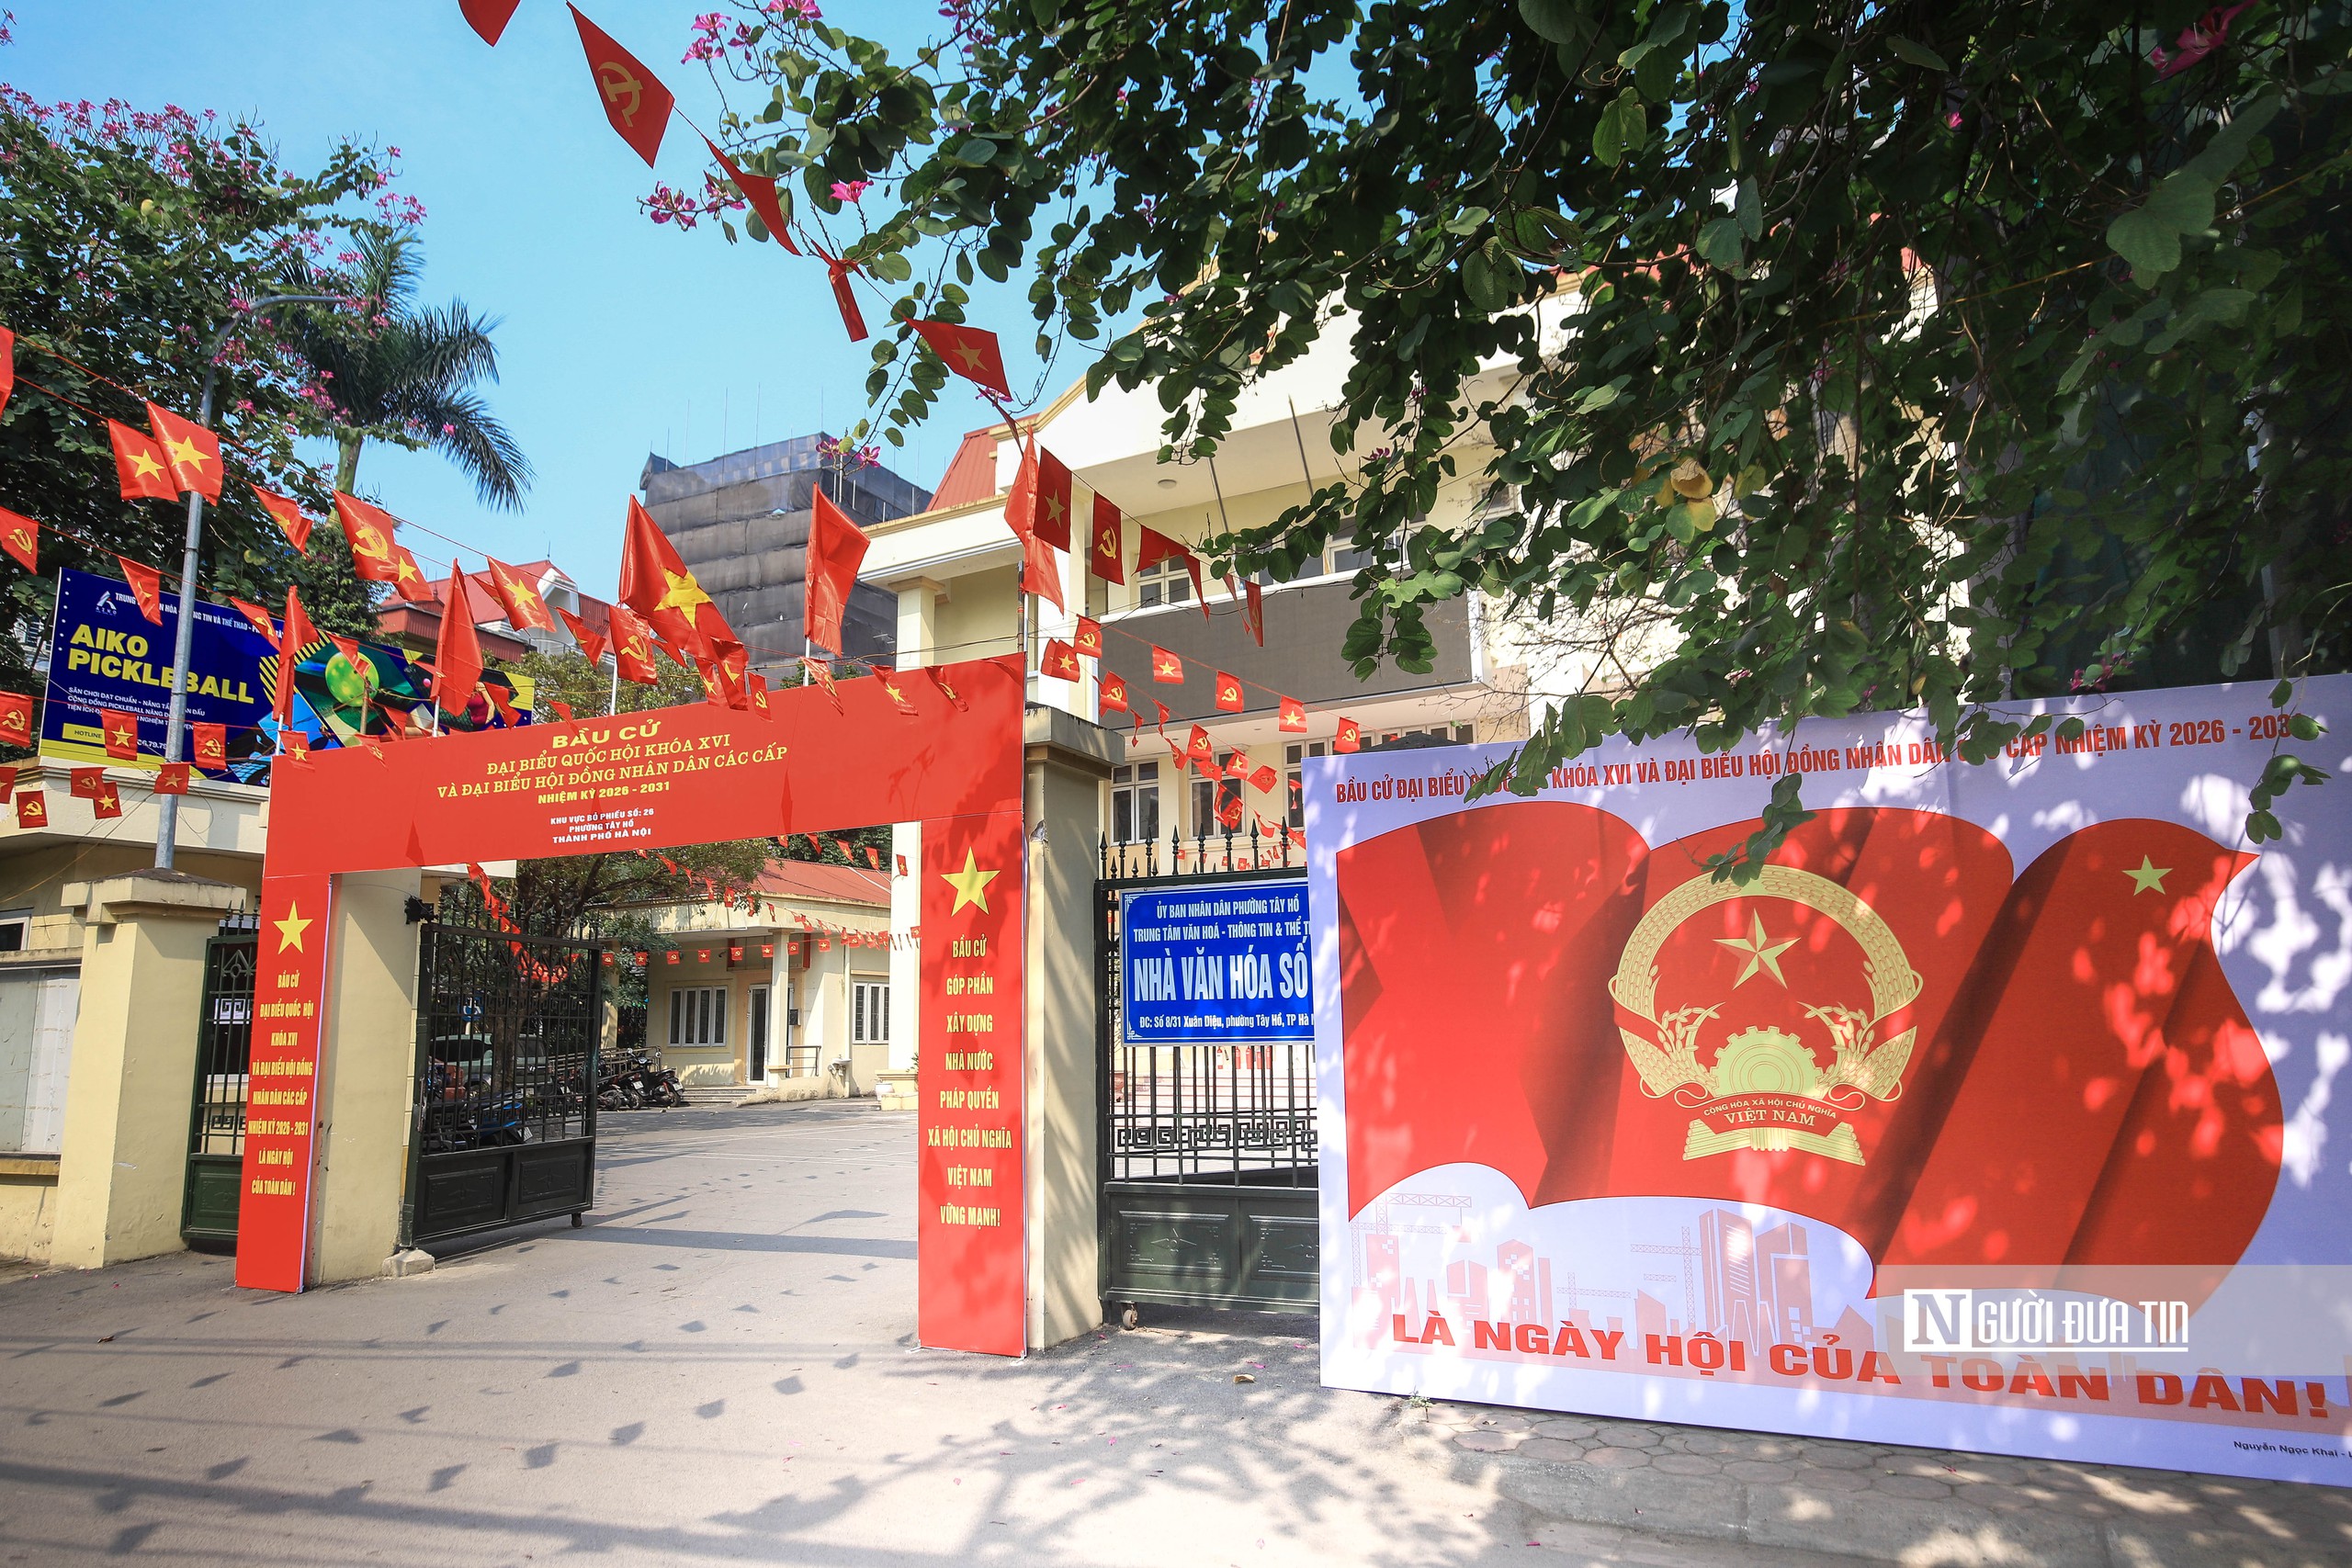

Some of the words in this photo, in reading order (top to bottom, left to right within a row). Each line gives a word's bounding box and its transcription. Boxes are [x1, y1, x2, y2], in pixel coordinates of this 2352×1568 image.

[116, 592, 136, 604] TRUNG
[202, 614, 212, 623] TIN
[233, 621, 248, 630] THAO
[70, 624, 148, 658] AIKO
[68, 648, 254, 704] PICKLEBALL
[108, 702, 144, 714] PICKLEBALL
[74, 729, 103, 739] HOTLINE
[553, 728, 610, 748] BẦU
[619, 718, 662, 740] CỬ
[487, 761, 515, 775] ĐẠI
[519, 750, 557, 772] BIỂU
[561, 746, 606, 766] QUỐC
[610, 743, 640, 761] HỘI
[645, 738, 693, 757] KHÓA
[698, 734, 730, 750] XVI
[1337, 776, 1367, 803] BẦU
[1372, 773, 1394, 800] CỬ
[1396, 778, 1422, 802] ĐẠI
[1428, 768, 1464, 796] BIỂU
[1552, 762, 1599, 788] KHÓA
[1603, 763, 1632, 785] XVI
[1636, 758, 1660, 783] VÀ
[1665, 759, 1695, 785] ĐẠI
[1749, 750, 1781, 780] HỘI
[1787, 744, 1839, 773] ĐỒNG
[1846, 740, 1902, 770] NHÂN
[2055, 724, 2128, 757] NHIỆM
[2133, 719, 2161, 749] KỲ
[2170, 719, 2225, 746] 2026
[437, 783, 458, 798] VÀ
[461, 783, 489, 797] ĐẠI
[494, 772, 531, 793] BIỂU
[535, 772, 564, 790] HỘI
[569, 766, 616, 784] ĐỒNG
[619, 761, 669, 779] NHÂN
[673, 756, 710, 773] DÂN
[715, 750, 748, 768] CÁC
[752, 742, 787, 762] CẤP
[538, 790, 577, 804] NHIỆM
[581, 788, 595, 800] KỲ
[599, 786, 629, 798] 2026
[640, 781, 670, 794] 2031
[550, 817, 567, 825] KHU
[570, 815, 584, 824] VỰC
[587, 812, 598, 821] BỎ
[601, 809, 625, 819] PHIẾU
[627, 807, 641, 818] SỐ:
[570, 823, 603, 832] PHƯỜNG
[606, 821, 620, 830] TÂY
[553, 834, 588, 843] THÀNH
[590, 830, 612, 840] PHỐ
[615, 829, 628, 838] HÀ
[632, 828, 651, 838] NỘI
[1157, 900, 1168, 919] ỦY
[1170, 904, 1186, 919] BAN
[1189, 900, 1211, 917] NHÂN
[1214, 899, 1231, 916] DÂN
[1233, 897, 1268, 915] PHƯỜNG
[1270, 897, 1284, 913] TÂY
[1288, 893, 1300, 913] HỒ
[1134, 928, 1160, 942] TRUNG
[1163, 924, 1181, 941] TÂM
[1183, 924, 1200, 940] VĂN
[1203, 922, 1220, 939] HOÁ
[1227, 921, 1256, 938] THÔNG
[1259, 922, 1273, 937] TIN
[1275, 922, 1283, 937] &
[1284, 916, 1301, 936] THỂ
[952, 934, 971, 957] BẦU
[974, 933, 987, 957] CỬ
[277, 970, 290, 988] BẦU
[290, 970, 300, 988] CỬ
[1134, 948, 1176, 1001] NHÀ
[1182, 946, 1224, 1000] VĂN
[1229, 944, 1273, 999] HÓA
[1279, 936, 1308, 998] SỐ
[946, 974, 965, 996] GÓP
[967, 970, 993, 995] PHẦN
[260, 1003, 270, 1020] ĐẠI
[271, 998, 285, 1018] BIỂU
[285, 998, 301, 1018] QUỐC
[303, 1000, 314, 1020] HỘI
[946, 1011, 965, 1032] XÂY
[967, 1013, 993, 1036] DỰNG
[1140, 1016, 1152, 1028] ĐC:
[1154, 1014, 1164, 1027] Số
[1165, 1016, 1182, 1028] 8/31
[1183, 1015, 1203, 1027] Xuân
[1204, 1014, 1224, 1030] Diệu,
[1226, 1014, 1254, 1028] phường
[1256, 1014, 1270, 1028] Tây
[1272, 1012, 1284, 1027] Hồ,
[1286, 1014, 1296, 1026] TP
[1298, 1013, 1308, 1026] Hà
[271, 1030, 287, 1045] KHÓA
[287, 1032, 298, 1045] XVI
[252, 1059, 259, 1076] VÀ
[261, 1062, 270, 1078] ĐẠI
[271, 1056, 285, 1076] BIỂU
[285, 1059, 296, 1078] HỘI
[296, 1057, 312, 1076] ĐỒNG
[945, 1049, 965, 1071] NHÀ
[967, 1049, 993, 1071] NƯỚC
[253, 1089, 269, 1105] NHÂN
[270, 1089, 282, 1105] DÂN
[283, 1089, 294, 1106] CÁC
[296, 1087, 307, 1106] CẤP
[940, 1087, 965, 1109] PHÁP
[1703, 1103, 1729, 1117] CỘNG
[1730, 1100, 1749, 1109] HÒA
[1752, 1098, 1765, 1106] XÃ
[1768, 1100, 1782, 1108] HỘI
[1786, 1100, 1805, 1110] CHỦ
[1808, 1104, 1837, 1119] NGHĨA
[1724, 1108, 1767, 1124] VIỆT
[1772, 1110, 1815, 1126] NAM
[248, 1118, 266, 1137] NHIỆM
[267, 1118, 276, 1135] KỲ
[276, 1121, 290, 1135] 2026
[294, 1122, 309, 1136] 2031
[928, 1125, 941, 1146] XÃ
[943, 1125, 958, 1151] HỘI
[961, 1123, 979, 1147] CHỦ
[981, 1126, 1012, 1148] NGHĨA
[258, 1147, 266, 1165] LÀ
[266, 1148, 283, 1165] NGÀY
[283, 1148, 294, 1168] HỘI
[252, 1176, 263, 1194] CỦA
[265, 1178, 279, 1195] TOÀN
[947, 1164, 968, 1190] VIỆT
[970, 1168, 992, 1187] NAM
[941, 1202, 966, 1225] VỮNG
[968, 1207, 1001, 1230] MẠNH!
[1393, 1311, 1455, 1347] LÀ
[1474, 1320, 1624, 1360] NGÀY
[1645, 1331, 1747, 1376] HỘI
[1769, 1334, 1902, 1384] CỦA
[1920, 1355, 2110, 1402] TOÀN
[2135, 1367, 2329, 1418] DÂN!
